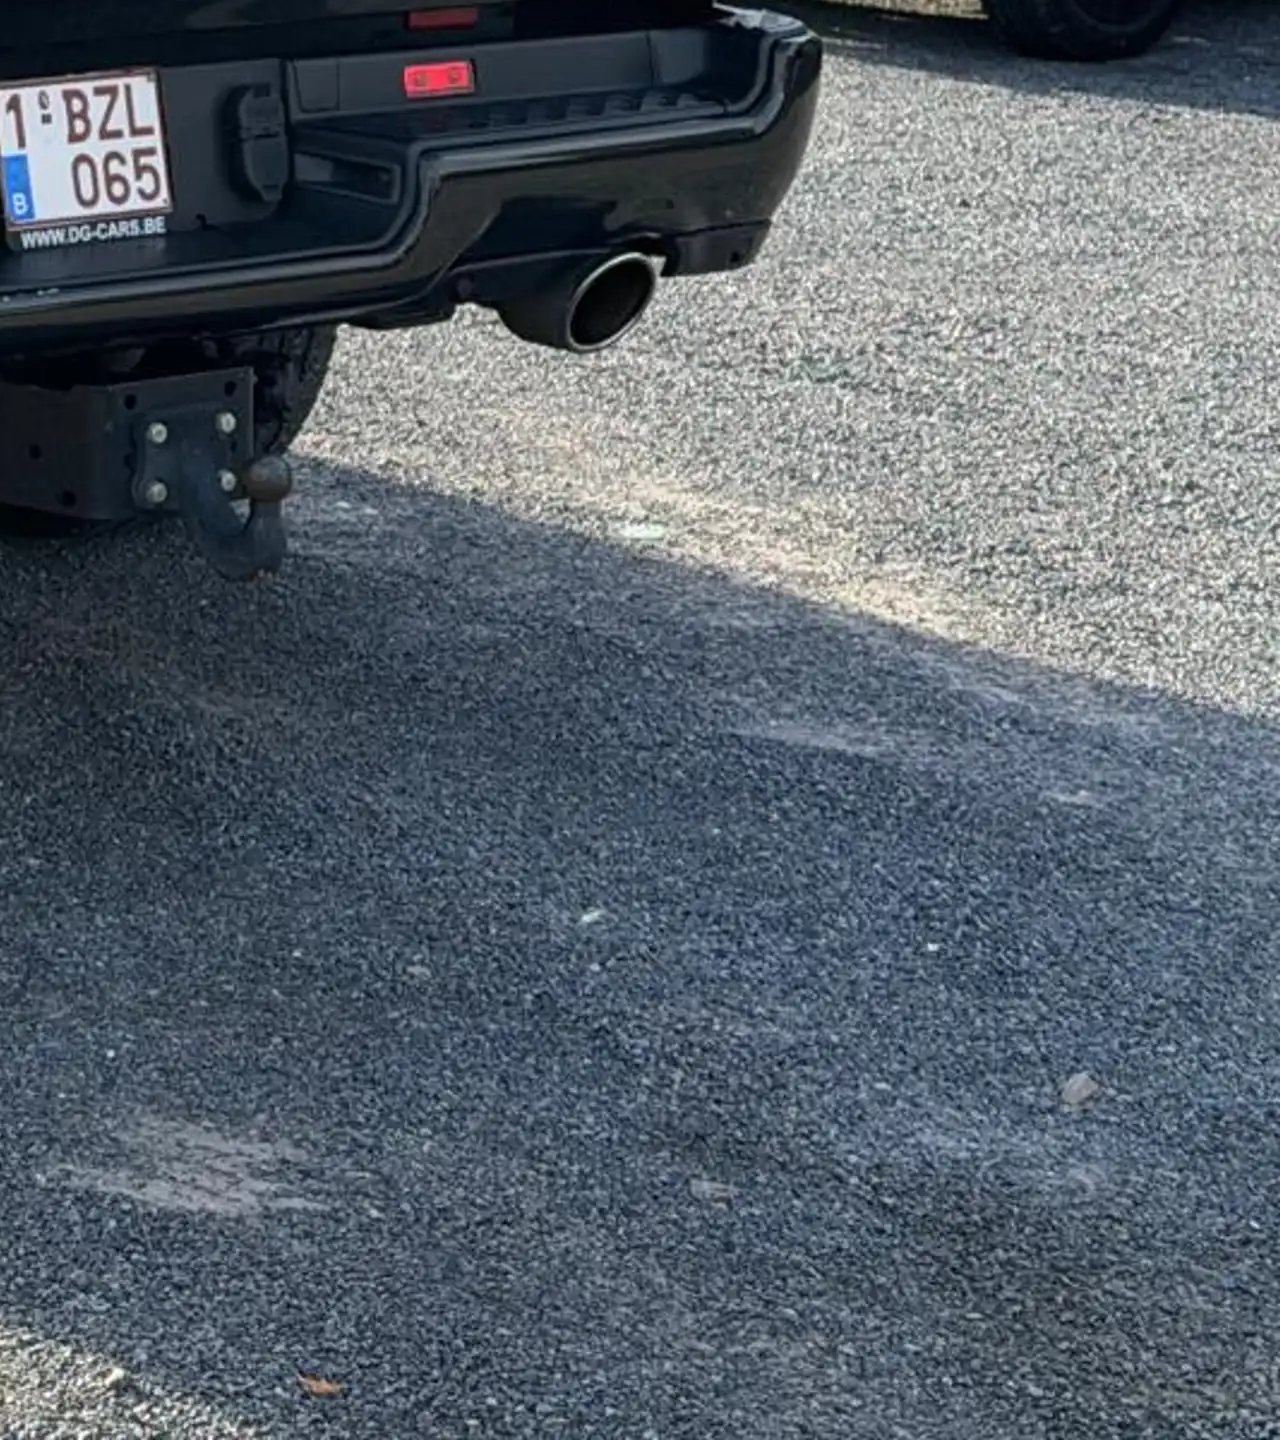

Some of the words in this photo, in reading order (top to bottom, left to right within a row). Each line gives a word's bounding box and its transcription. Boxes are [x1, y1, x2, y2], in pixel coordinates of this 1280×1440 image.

[70, 146, 162, 210] 065
[12, 192, 30, 216] B
[20, 215, 167, 251] WWW.DG-CARS.BE
